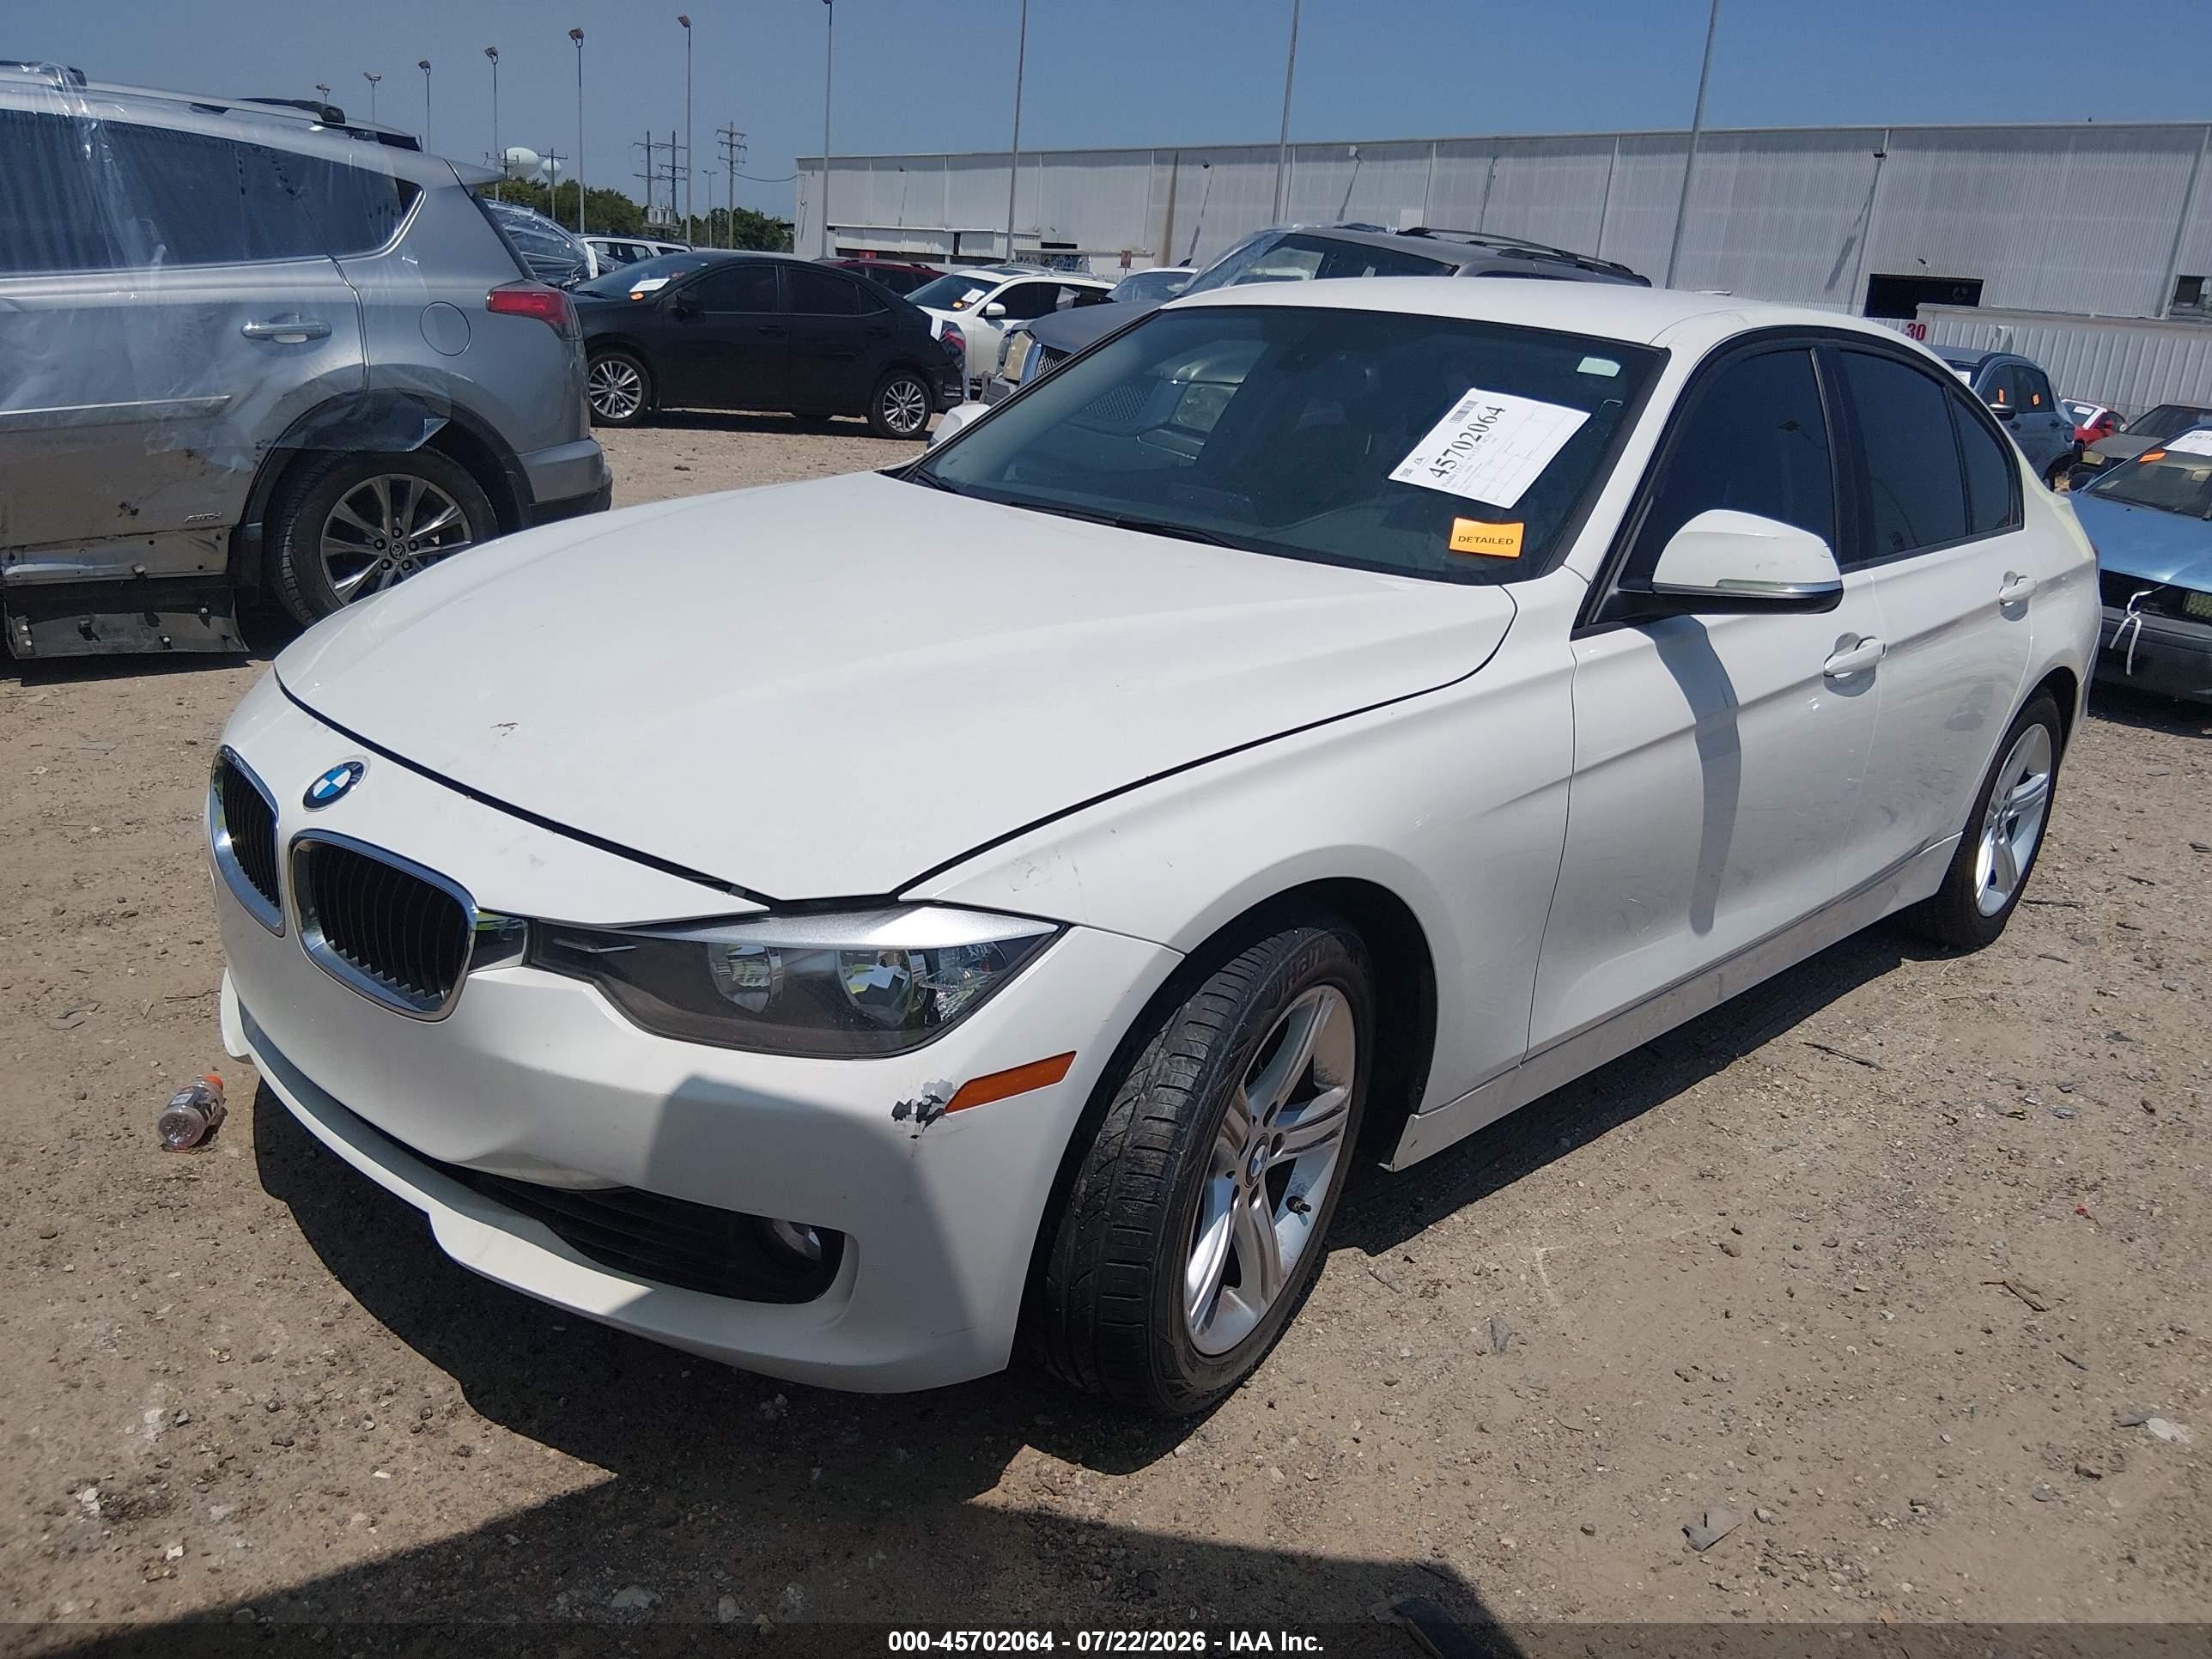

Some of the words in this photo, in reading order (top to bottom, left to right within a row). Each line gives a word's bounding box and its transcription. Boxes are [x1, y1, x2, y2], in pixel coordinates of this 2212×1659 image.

[1907, 323, 1927, 341] 30
[1428, 405, 1506, 478] 45702064
[1458, 535, 1514, 545] DETAILED
